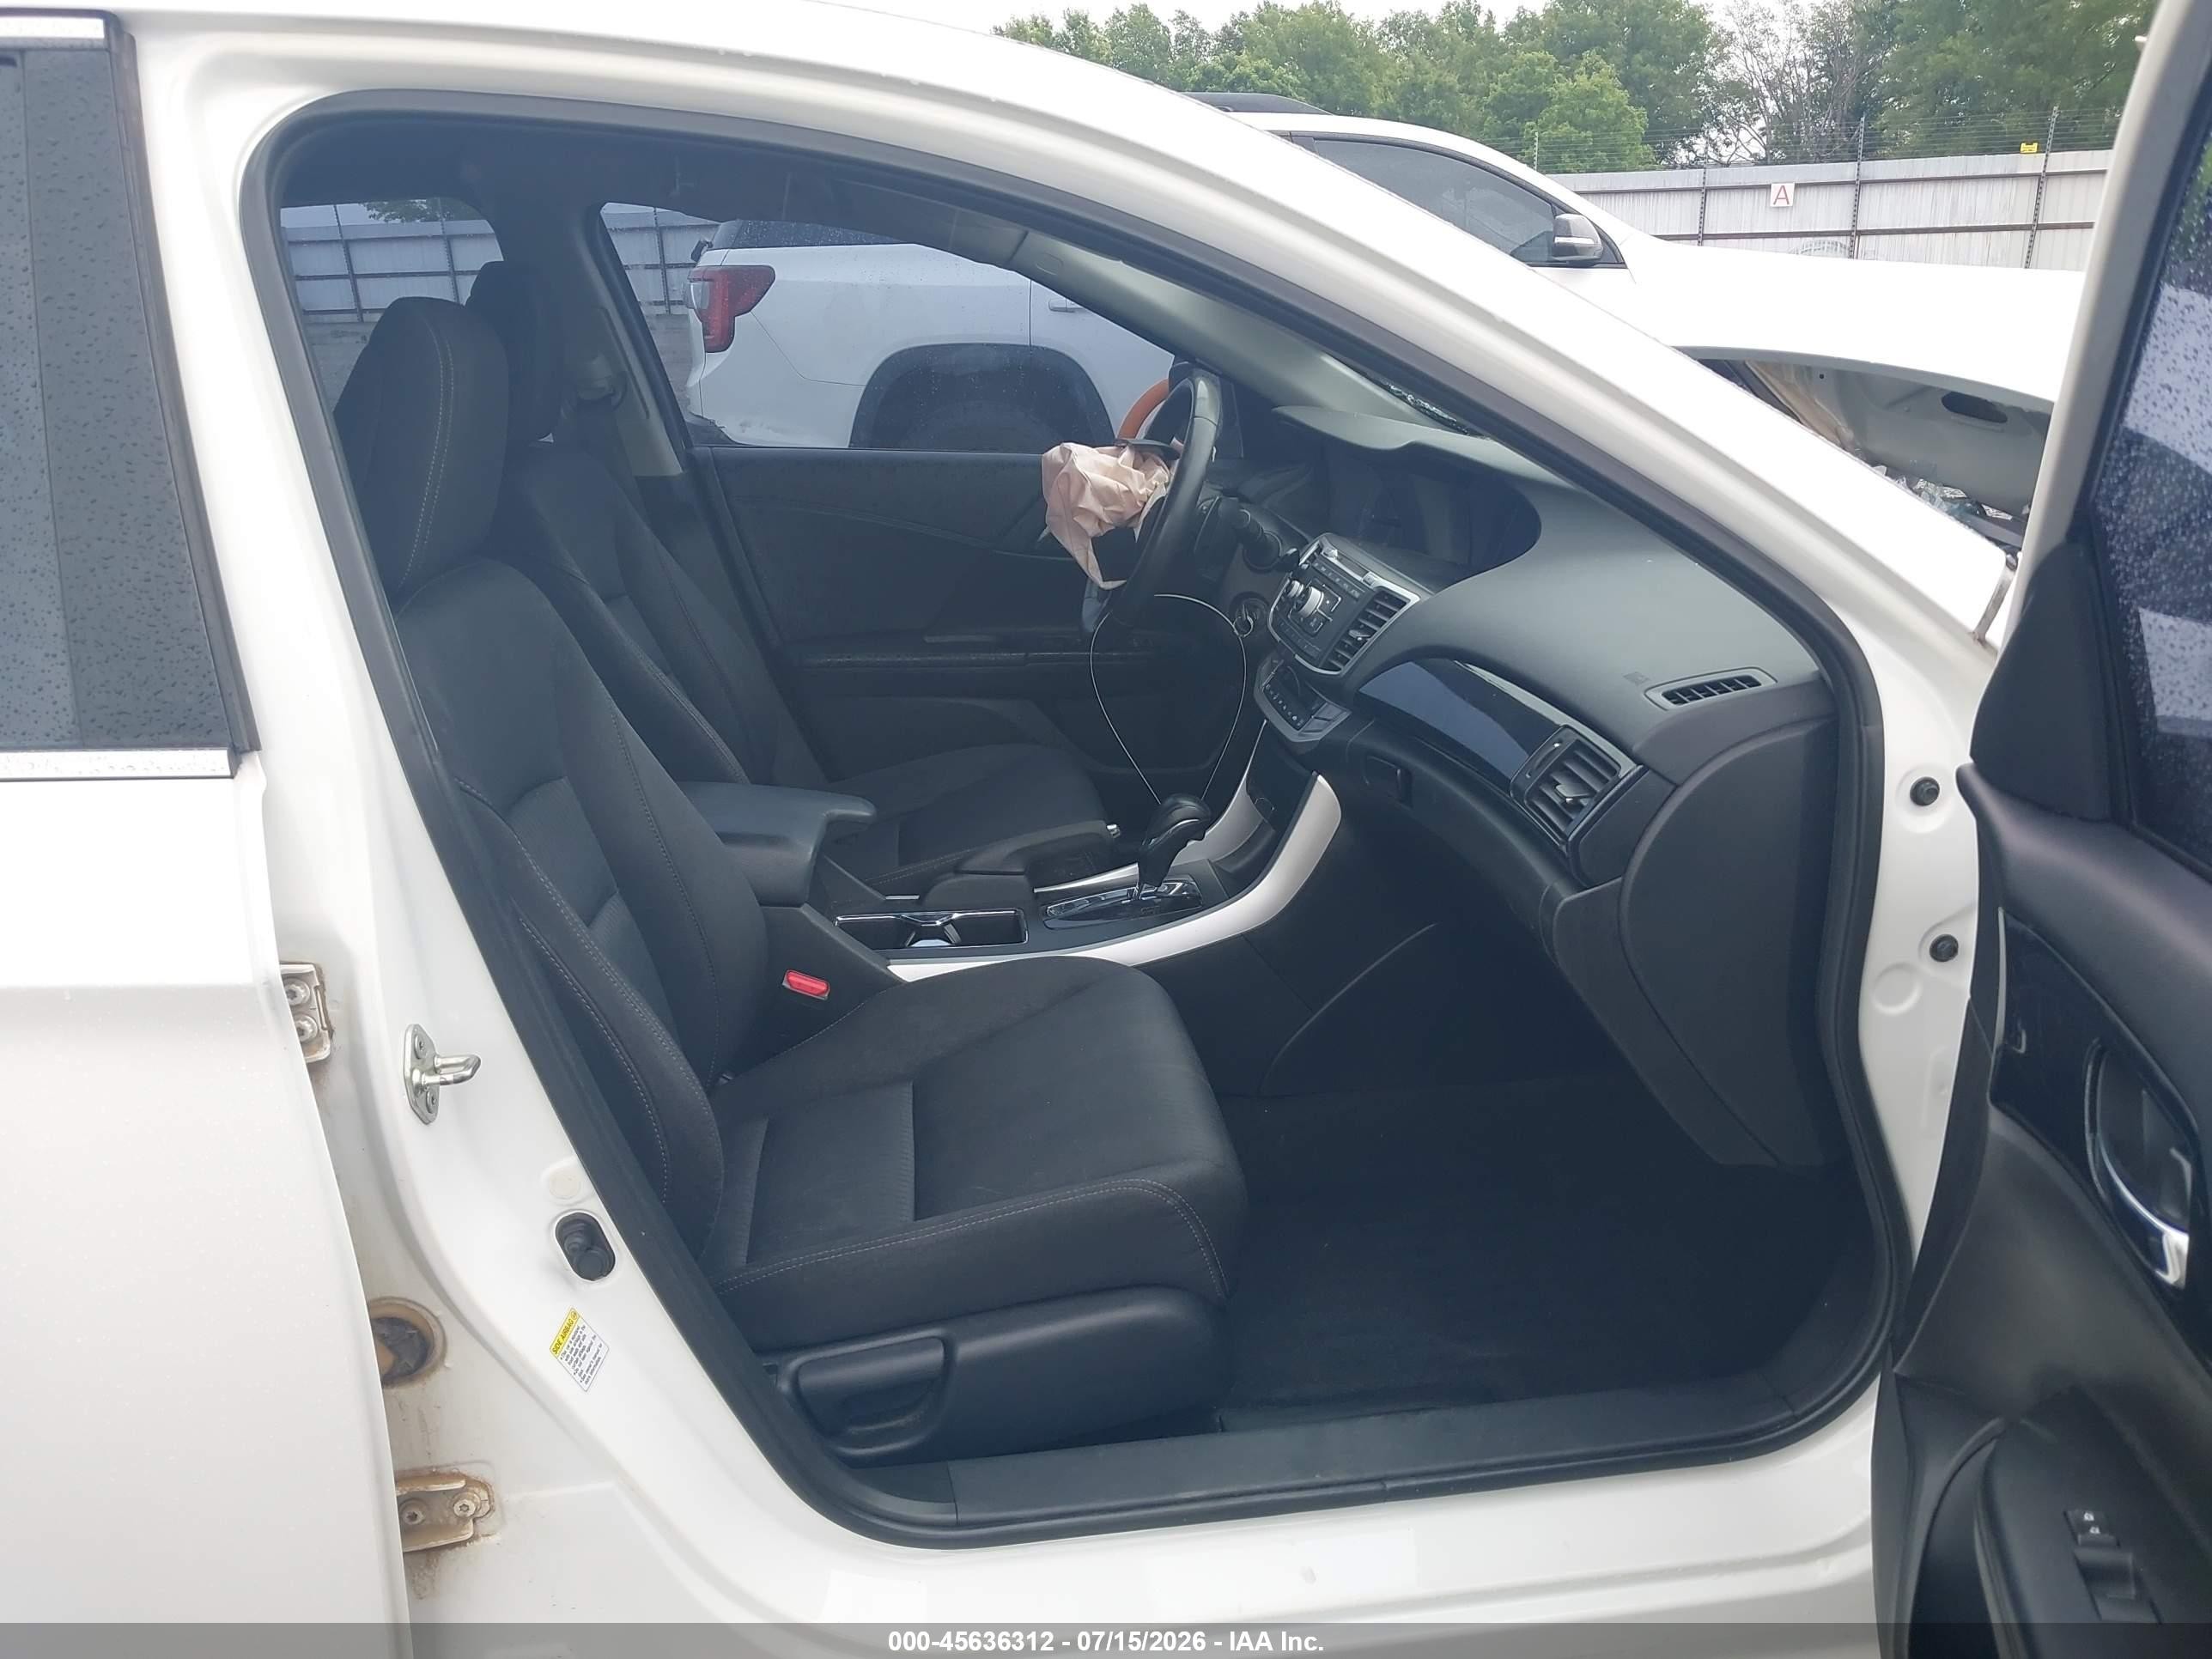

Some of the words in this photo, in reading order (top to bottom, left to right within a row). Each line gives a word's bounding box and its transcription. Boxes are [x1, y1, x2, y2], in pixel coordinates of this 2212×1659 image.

[1772, 185, 1790, 205] A
[552, 1339, 562, 1354] SIDE
[560, 1318, 574, 1340] AIRBAG
